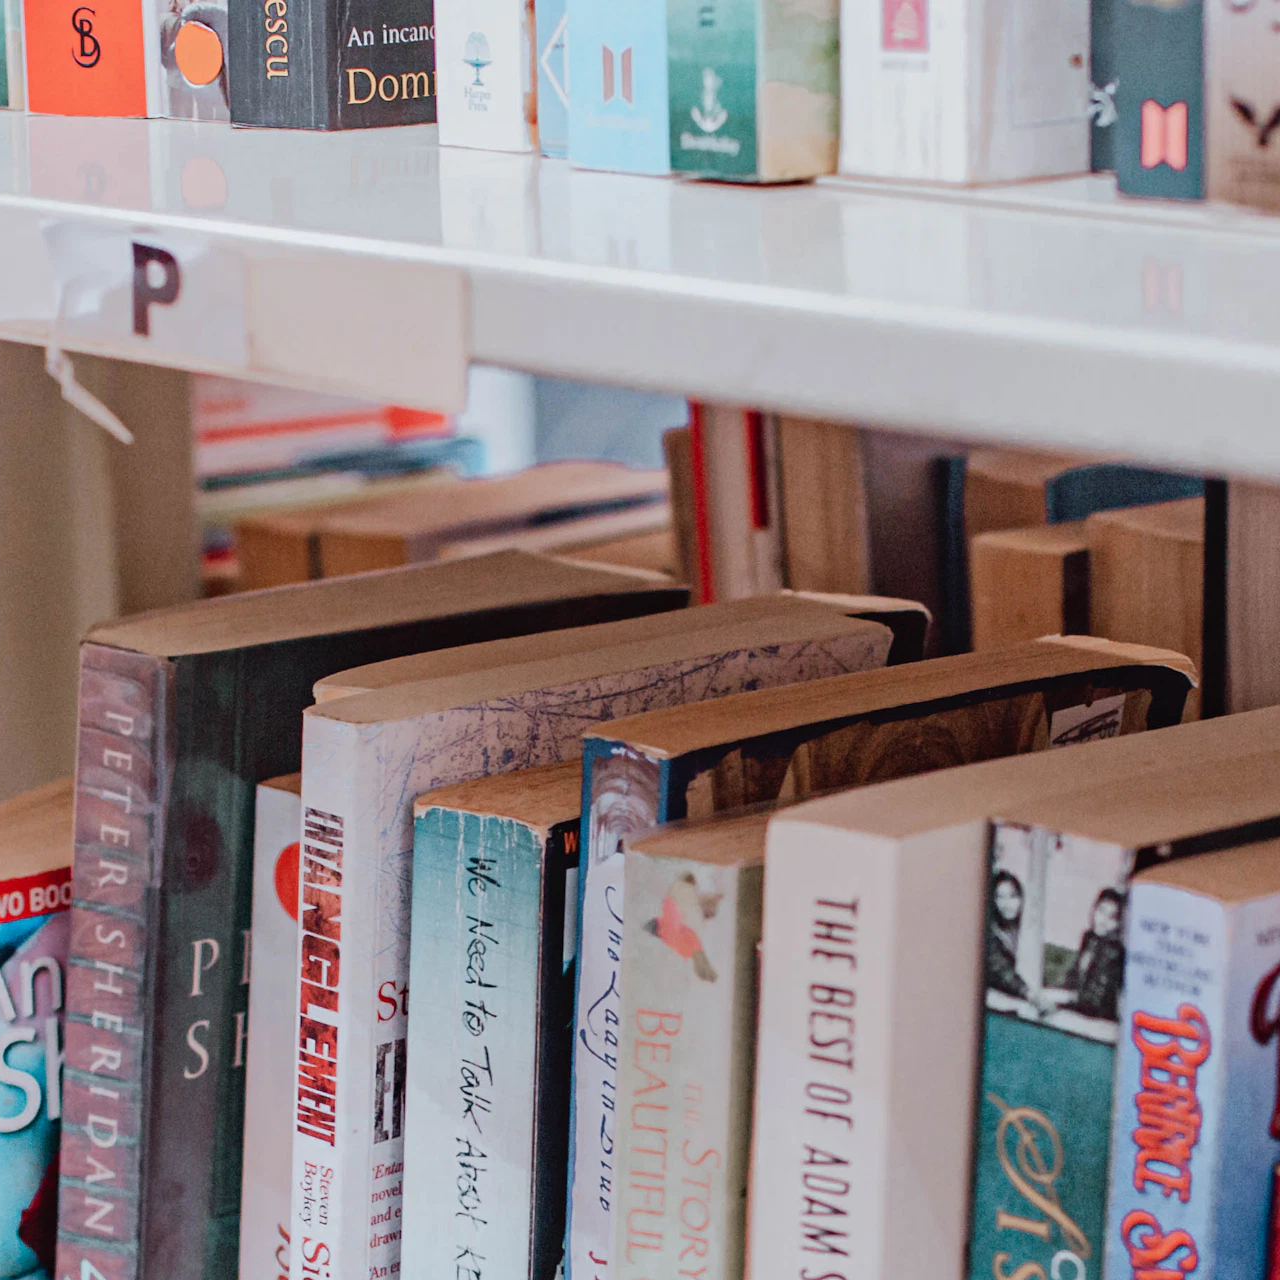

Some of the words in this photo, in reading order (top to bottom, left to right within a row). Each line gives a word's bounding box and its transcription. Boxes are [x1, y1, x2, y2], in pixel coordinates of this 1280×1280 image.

[347, 27, 374, 47] An
[345, 68, 436, 104] Dom
[132, 242, 180, 336] P
[98, 710, 134, 888] PETER
[465, 856, 501, 897] We
[465, 915, 499, 989] Need
[811, 896, 859, 971] THE
[297, 806, 345, 1147] ENTANGLEMENT
[464, 1000, 498, 1036] to
[808, 983, 857, 1072] BEST
[83, 922, 126, 1236] SHERIDAN
[459, 1046, 494, 1133] Talk
[804, 1082, 853, 1130] OF
[627, 1009, 683, 1264] BEAUTIFUL
[300, 1161, 318, 1228] Boykey
[320, 1165, 334, 1226] Steven
[371, 1211, 391, 1226] and
[801, 1144, 851, 1257] ADAM
